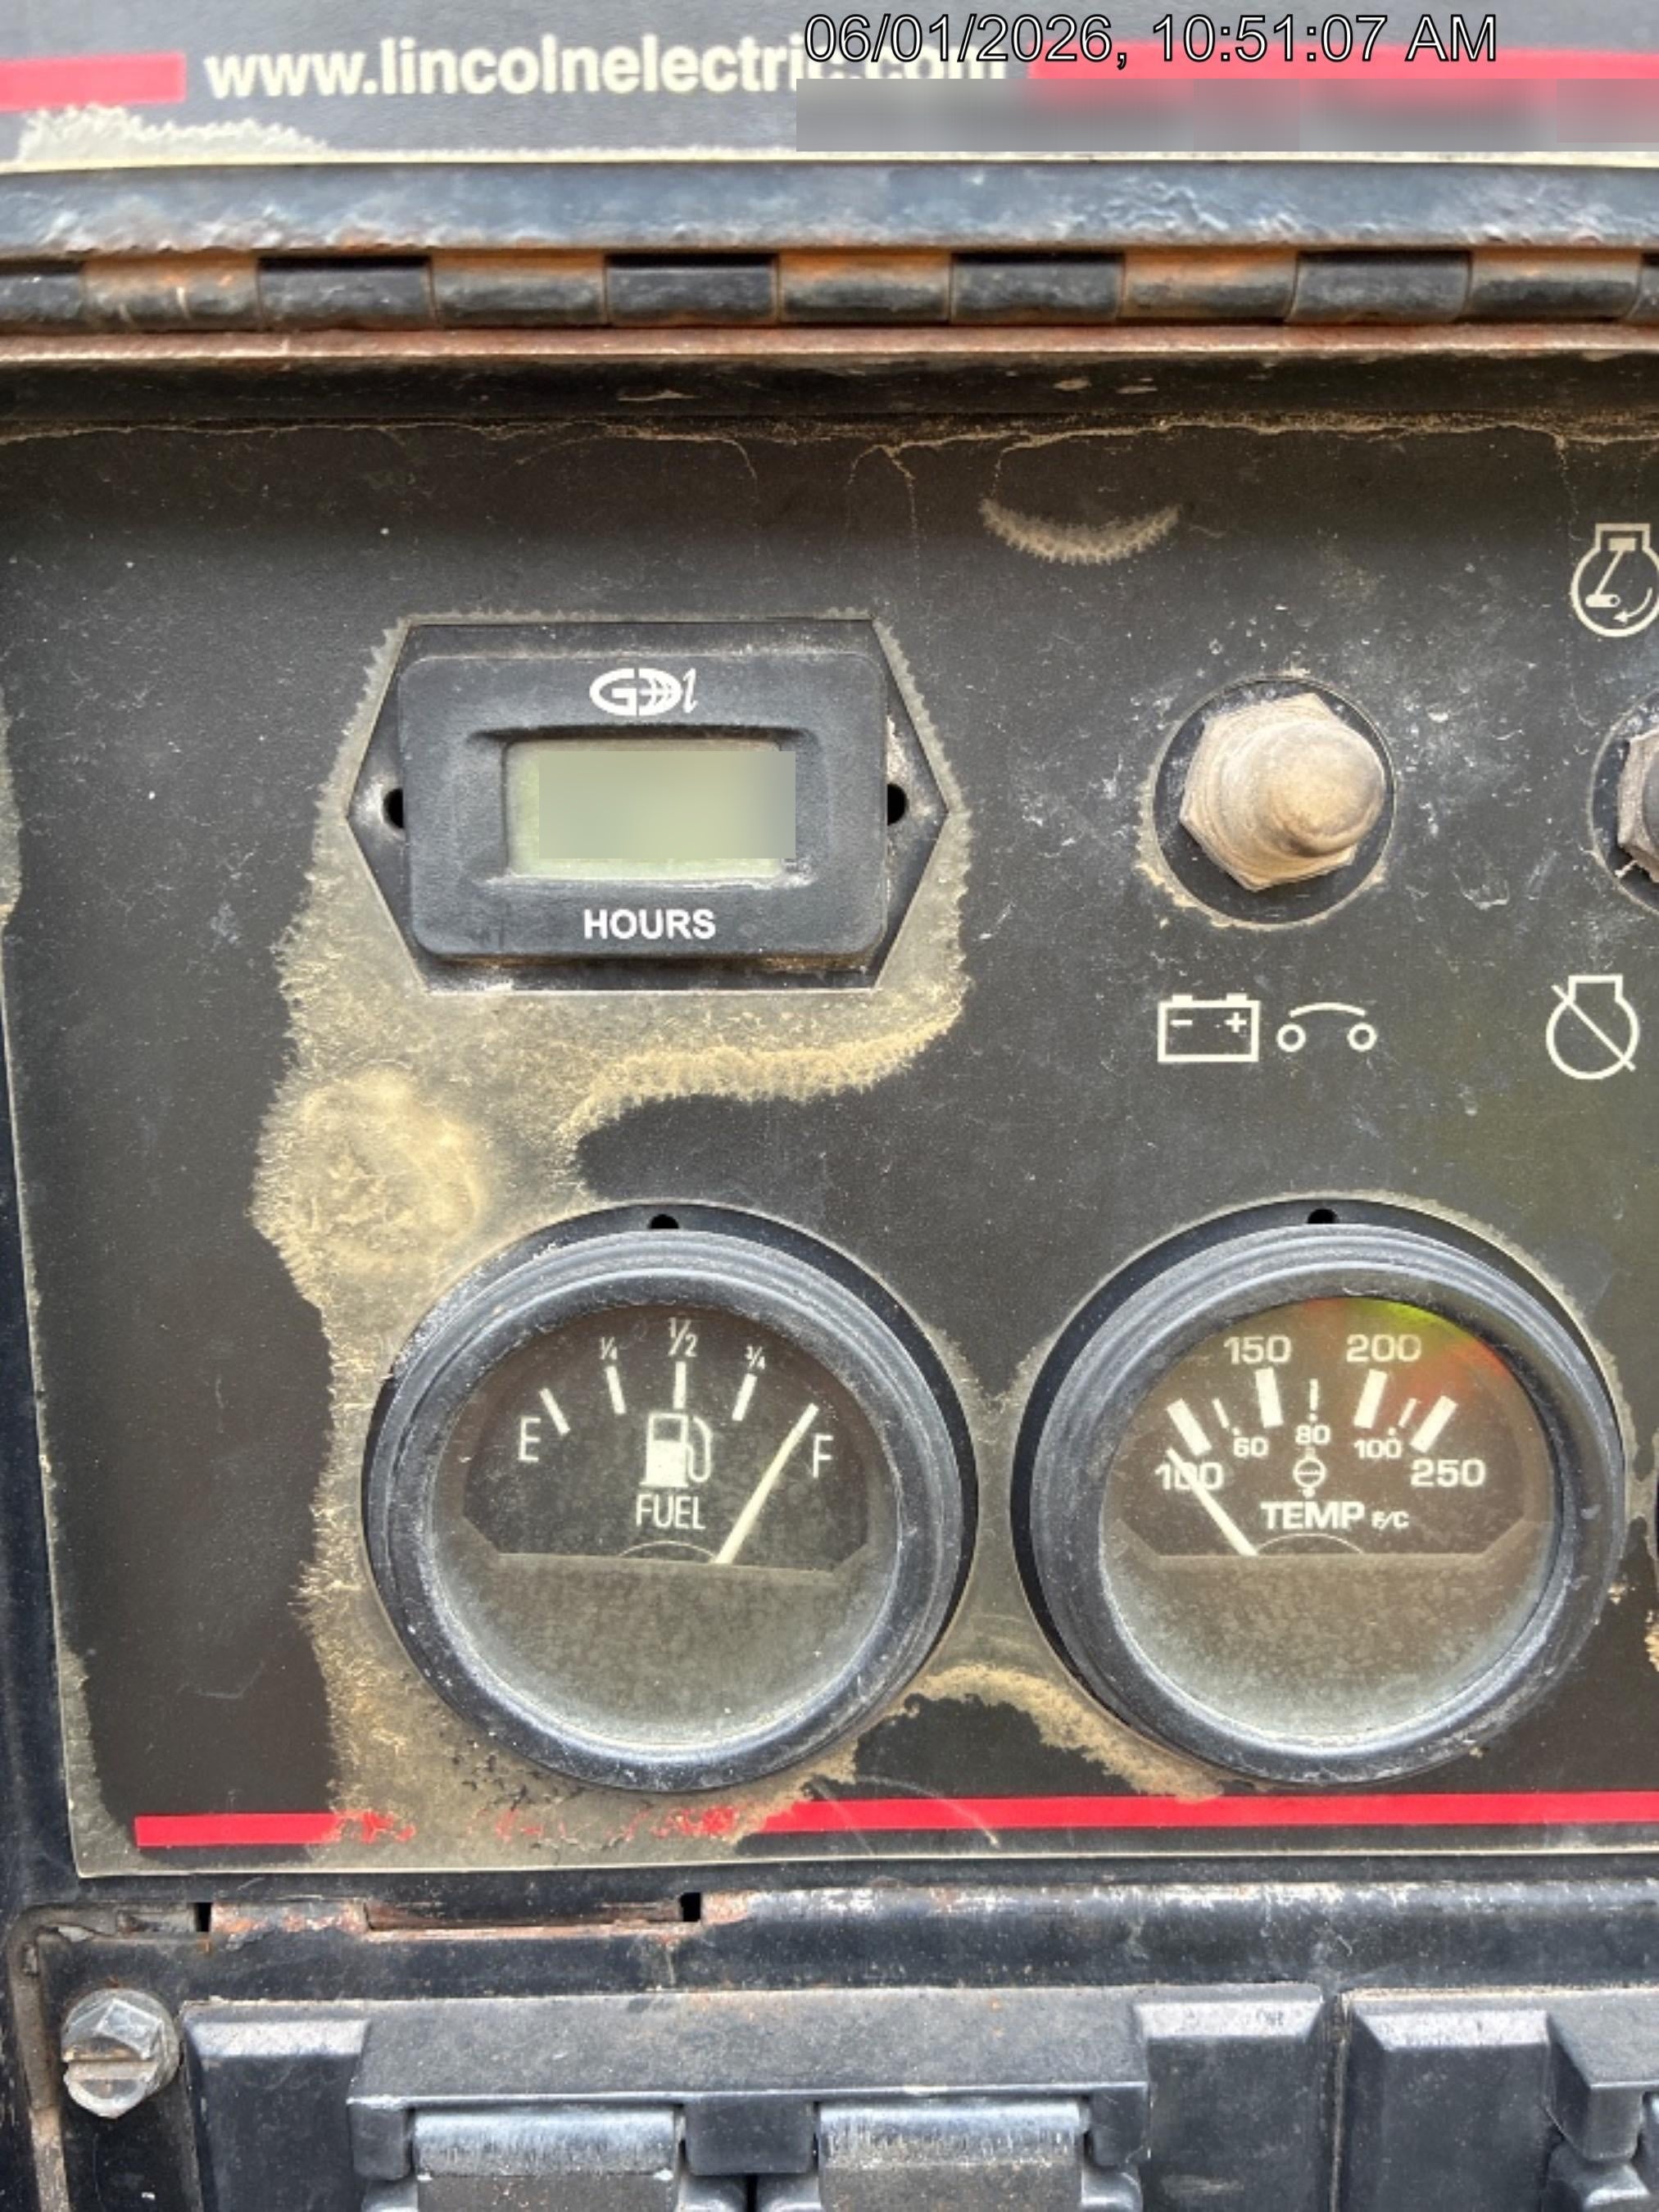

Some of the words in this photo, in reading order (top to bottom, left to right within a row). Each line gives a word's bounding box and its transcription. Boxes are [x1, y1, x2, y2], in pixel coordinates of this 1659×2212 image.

[205, 33, 1006, 97] www.lincolnelectriccom
[582, 909, 716, 940] HOURS
[1223, 1335, 1292, 1365] 150
[1346, 1333, 1421, 1363] 200
[518, 1417, 541, 1462] E
[1232, 1438, 1269, 1458] 60
[1294, 1425, 1331, 1446] 80
[1353, 1439, 1402, 1460] 100
[813, 1435, 833, 1478] F
[1410, 1458, 1487, 1488] 250
[635, 1494, 706, 1530] FUEL
[1261, 1501, 1365, 1530] TEMP
